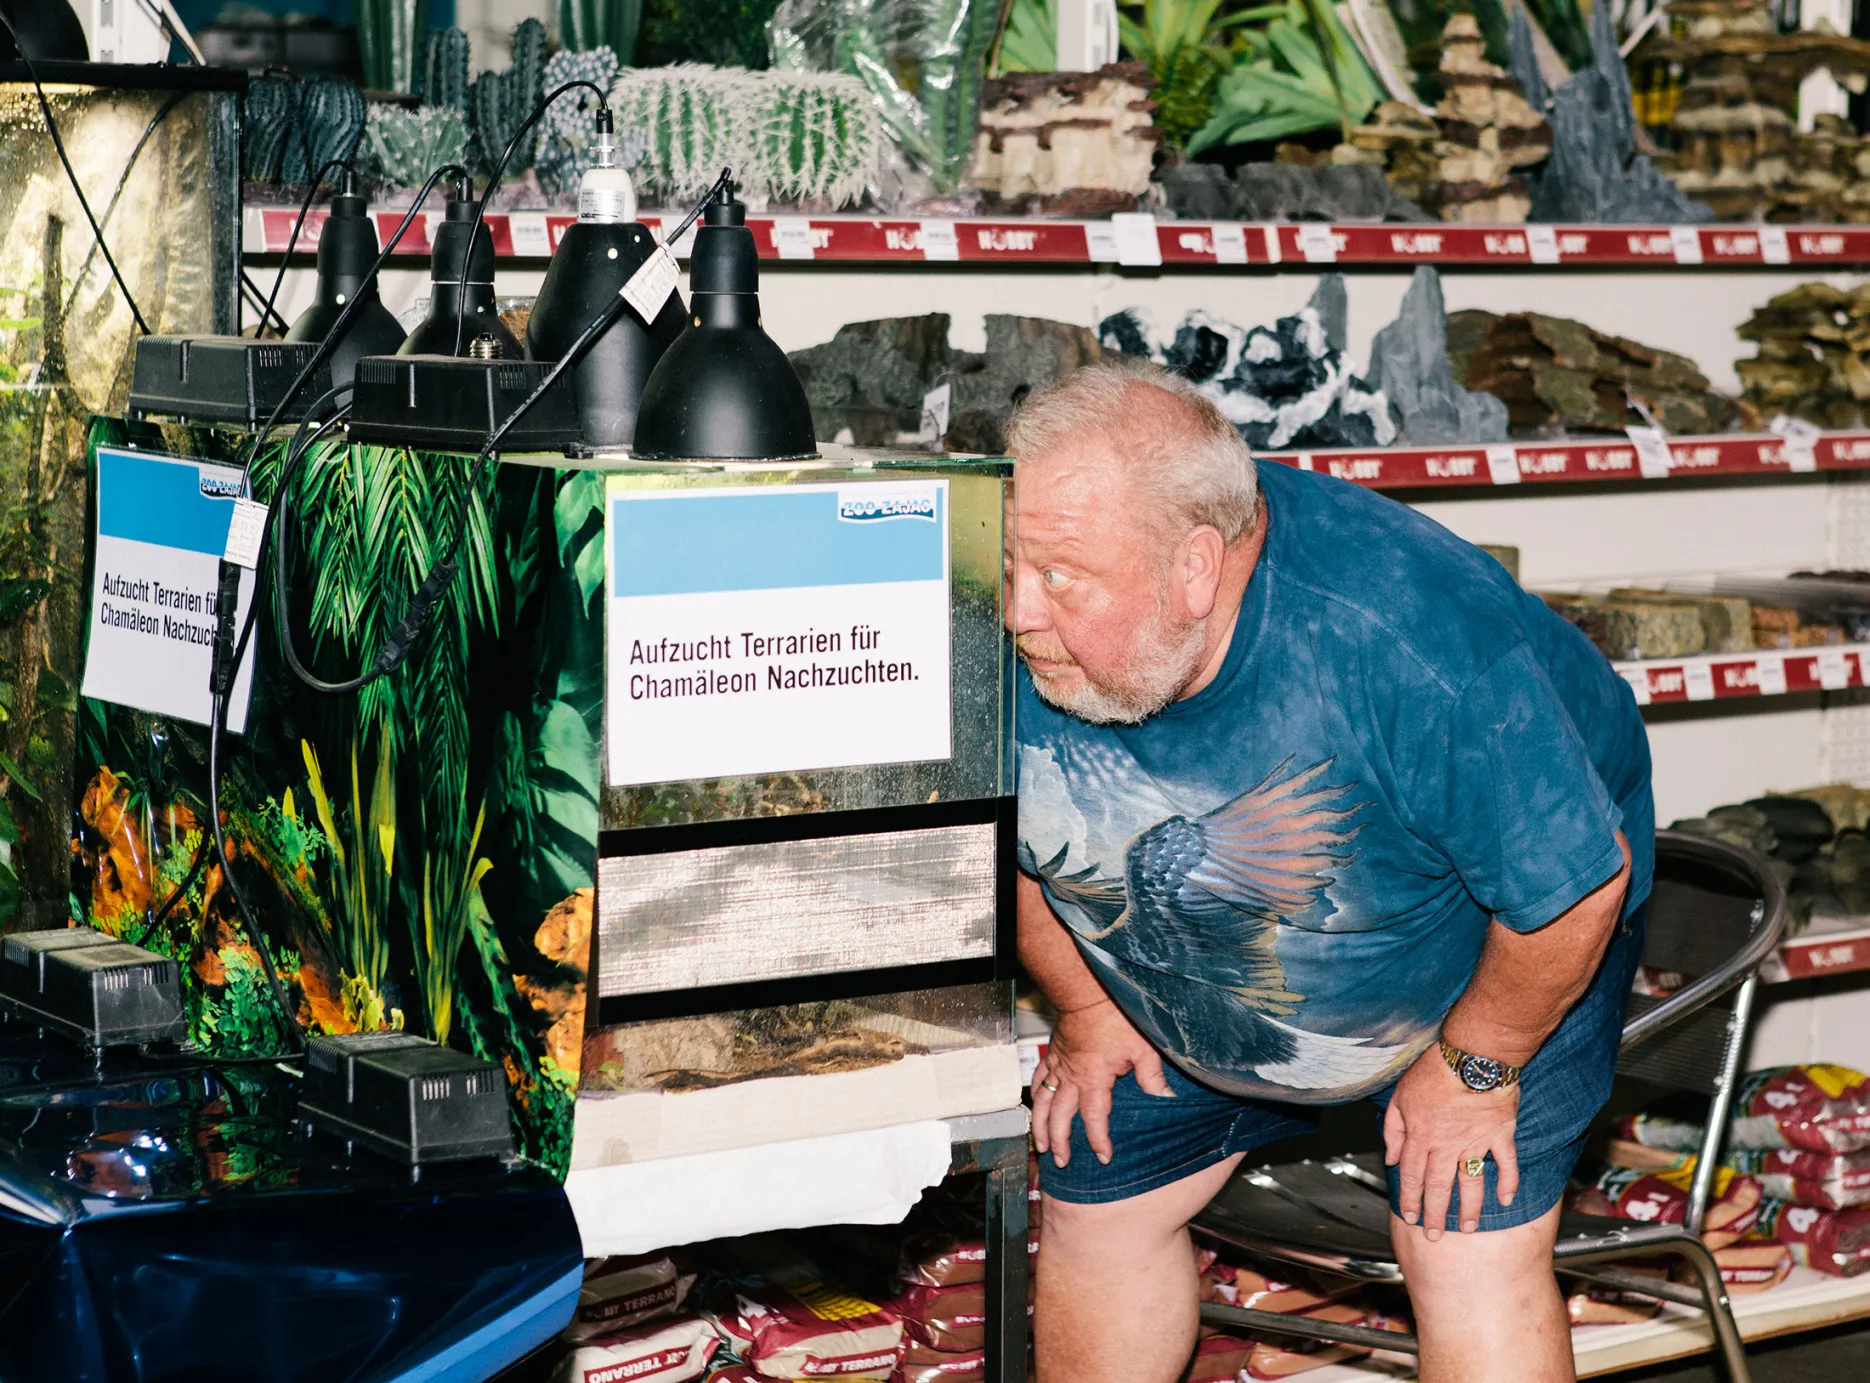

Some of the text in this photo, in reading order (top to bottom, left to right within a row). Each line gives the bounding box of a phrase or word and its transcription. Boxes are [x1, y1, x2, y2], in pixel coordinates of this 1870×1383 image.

[844, 501, 876, 517] ZOO
[103, 572, 217, 616] Aufzucht Terrarien fü
[101, 601, 217, 647] Chamäleon Nachzuch
[630, 624, 881, 665] Aufzucht Terrarien für
[630, 658, 919, 701] Chamäleon Nachzuchten.
[588, 1357, 662, 1383] TERRANO
[841, 1353, 896, 1372] TERRANO
